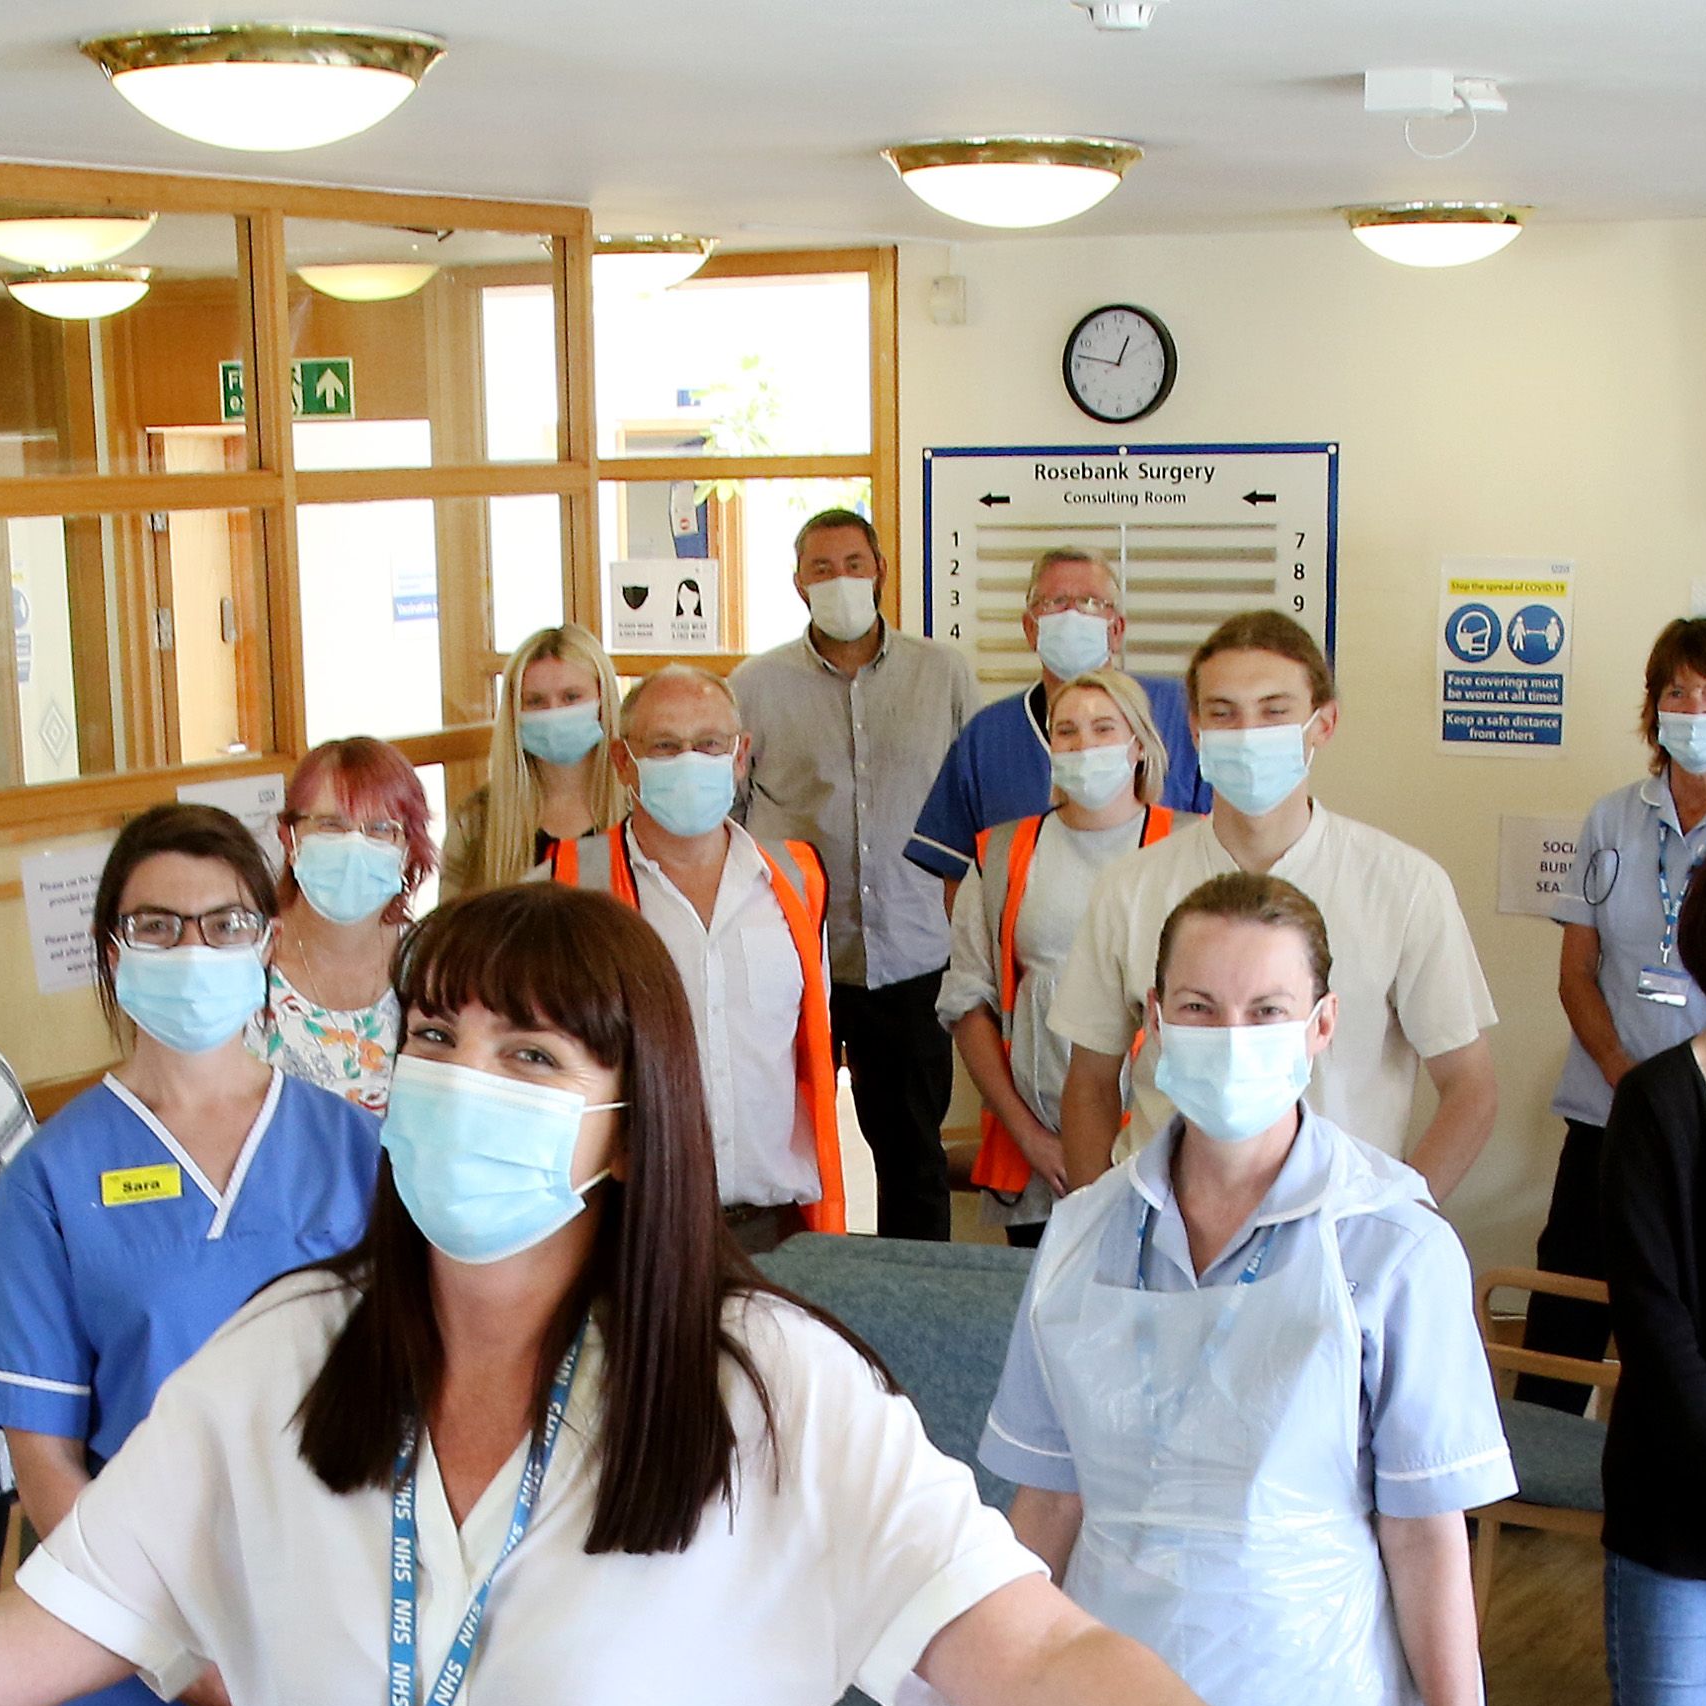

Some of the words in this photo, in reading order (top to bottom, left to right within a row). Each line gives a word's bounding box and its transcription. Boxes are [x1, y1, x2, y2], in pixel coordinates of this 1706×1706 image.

[1034, 461, 1129, 481] Rosebank
[1138, 462, 1215, 484] Surgery
[1063, 490, 1139, 506] Consulting
[1145, 491, 1187, 504] Room
[951, 531, 959, 547] 1
[1295, 532, 1305, 548] 7
[950, 560, 960, 575] 2
[1293, 563, 1305, 580] 8
[1485, 583, 1514, 592] spread
[1515, 583, 1524, 591] of
[1525, 584, 1565, 592] COVID-19
[950, 590, 960, 606] 3
[1293, 595, 1305, 612] 9
[950, 623, 960, 639] 4
[1447, 674, 1472, 686] Face
[1475, 676, 1528, 689] coverings
[1531, 678, 1559, 688] must
[1448, 689, 1462, 699] be
[1465, 691, 1494, 700] worn
[1497, 691, 1509, 700] at
[1511, 691, 1525, 701] all
[1528, 692, 1559, 702] times
[1446, 714, 1475, 726] Keep
[1476, 717, 1484, 726] a
[1486, 715, 1510, 725] safe
[1512, 716, 1559, 729] distance
[1469, 728, 1496, 739] from
[1498, 729, 1535, 741] others
[1540, 861, 1572, 873] BUB
[1535, 881, 1561, 893] SEA
[122, 1180, 161, 1193] Sara
[393, 1536, 412, 1582] NHS
[393, 1597, 412, 1645] NHS
[458, 1601, 484, 1649] NHS
